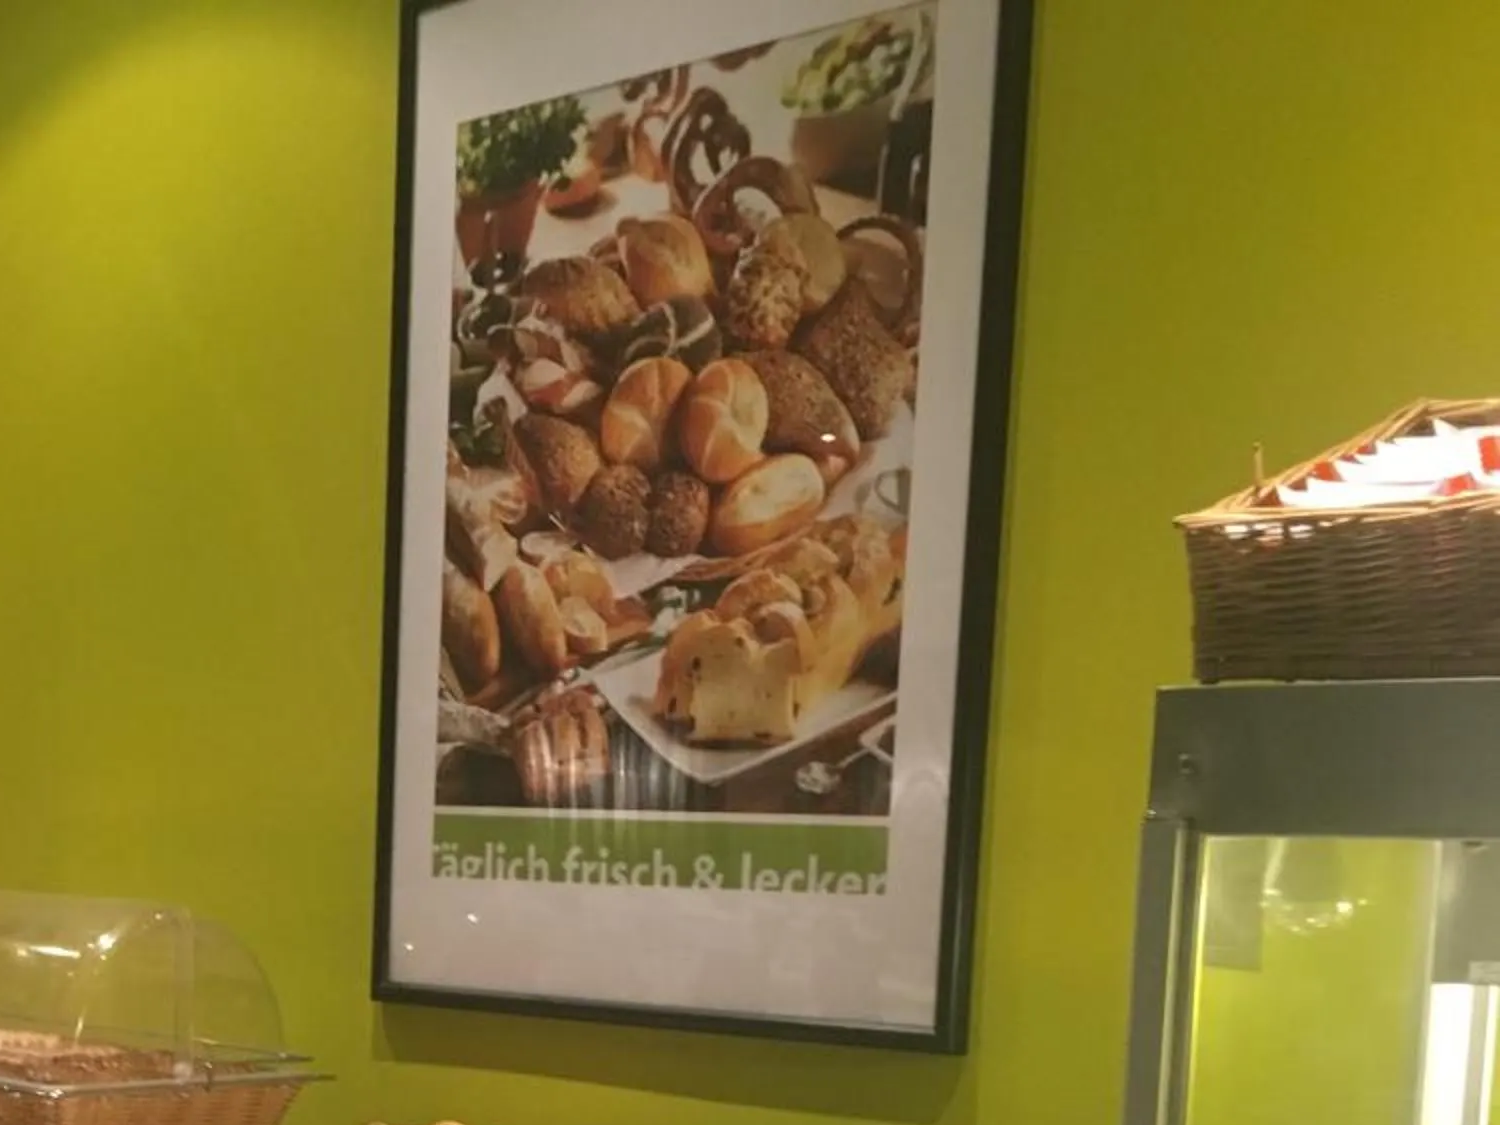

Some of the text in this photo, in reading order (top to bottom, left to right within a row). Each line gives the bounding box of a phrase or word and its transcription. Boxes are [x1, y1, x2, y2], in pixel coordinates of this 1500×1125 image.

[432, 842, 886, 895] äglich frisch & lecker
